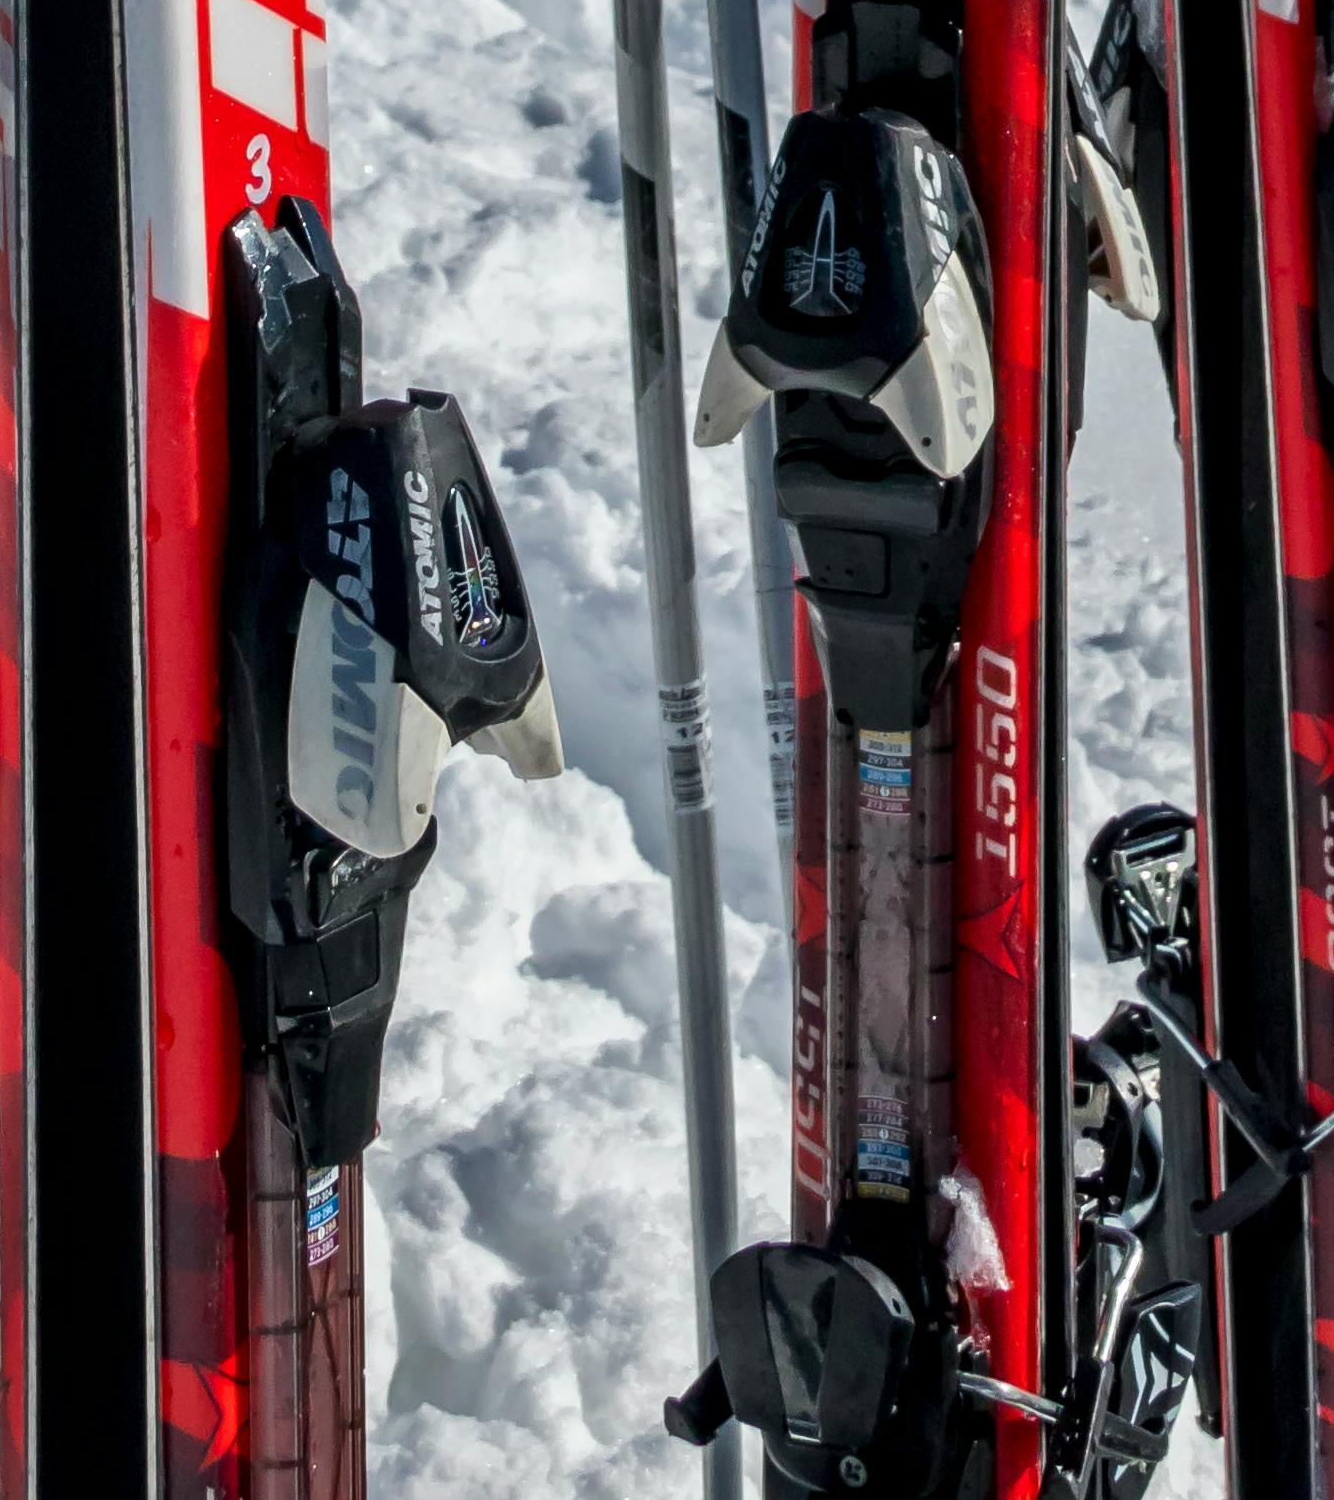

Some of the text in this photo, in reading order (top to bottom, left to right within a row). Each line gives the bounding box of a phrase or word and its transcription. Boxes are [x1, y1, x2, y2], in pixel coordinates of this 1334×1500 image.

[244, 132, 272, 205] 3
[327, 467, 378, 822] ATOMIC
[405, 471, 446, 647] ATOMIC
[976, 645, 1016, 878] 1550
